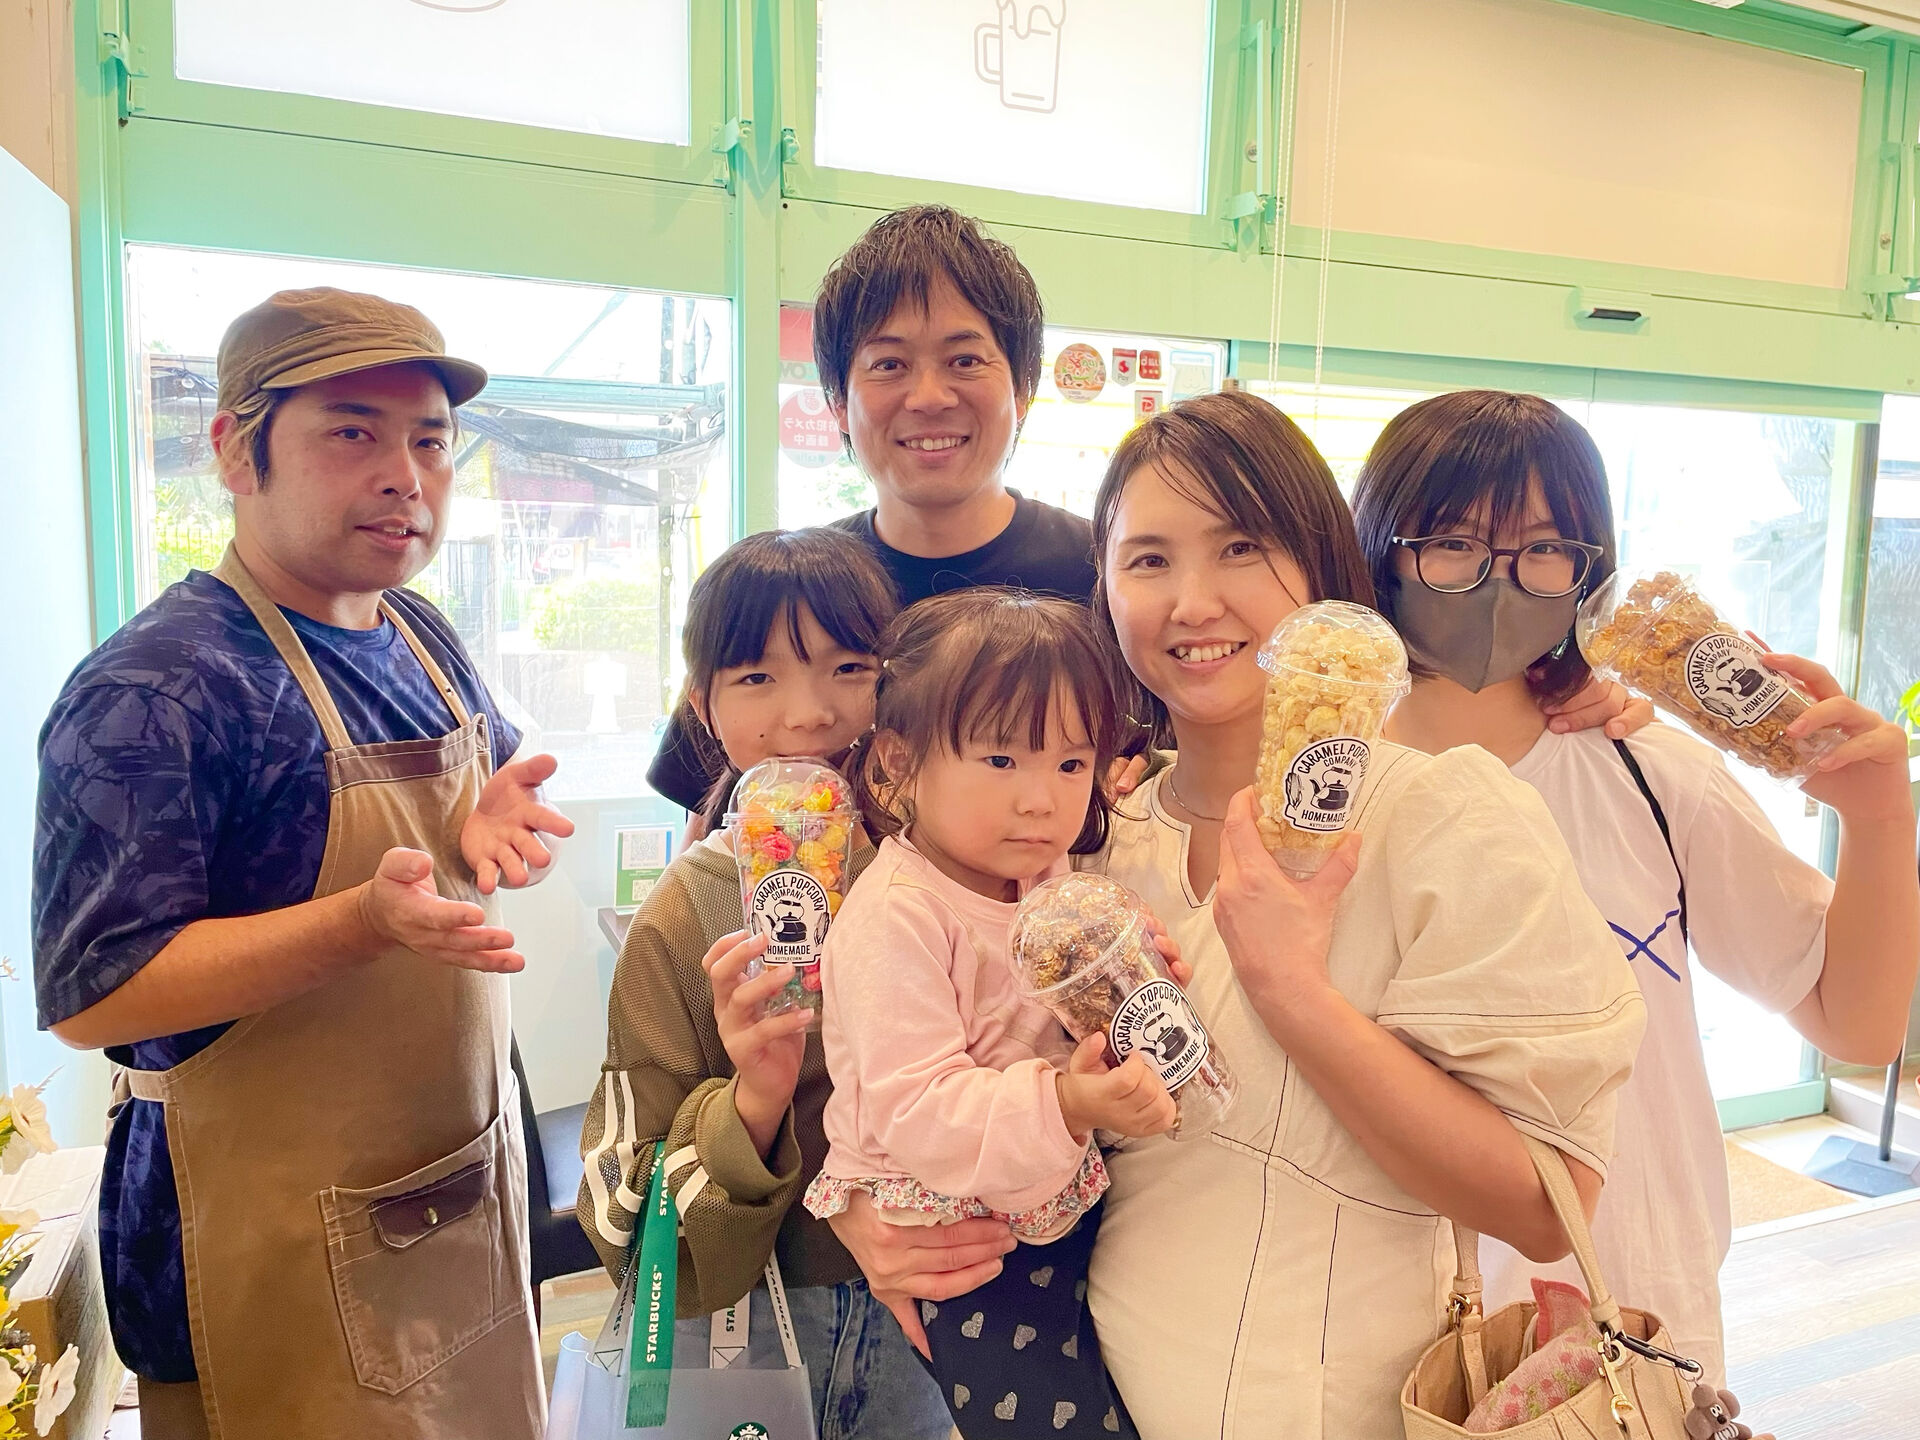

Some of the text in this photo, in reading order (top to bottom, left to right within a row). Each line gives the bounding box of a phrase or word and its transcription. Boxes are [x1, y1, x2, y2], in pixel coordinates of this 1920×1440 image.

[1691, 637, 1752, 695] CARAMEL POPCORN
[1704, 648, 1730, 673] COMPANY
[1741, 680, 1779, 716] HOMEMADE
[1297, 743, 1345, 774] CARAMEL
[1323, 755, 1358, 769] COMPANY
[1301, 809, 1346, 823] HOMEMADE
[756, 876, 824, 911] CARAMEL POPCORN
[771, 888, 805, 901] COMPANY
[767, 945, 811, 955] HOMEMADE
[1116, 986, 1182, 1053] CARAMEL POPCORN
[1132, 1001, 1162, 1031] COMPANY
[1160, 1040, 1201, 1081] HOMEMADE
[646, 1271, 662, 1363] STARBUCKS
